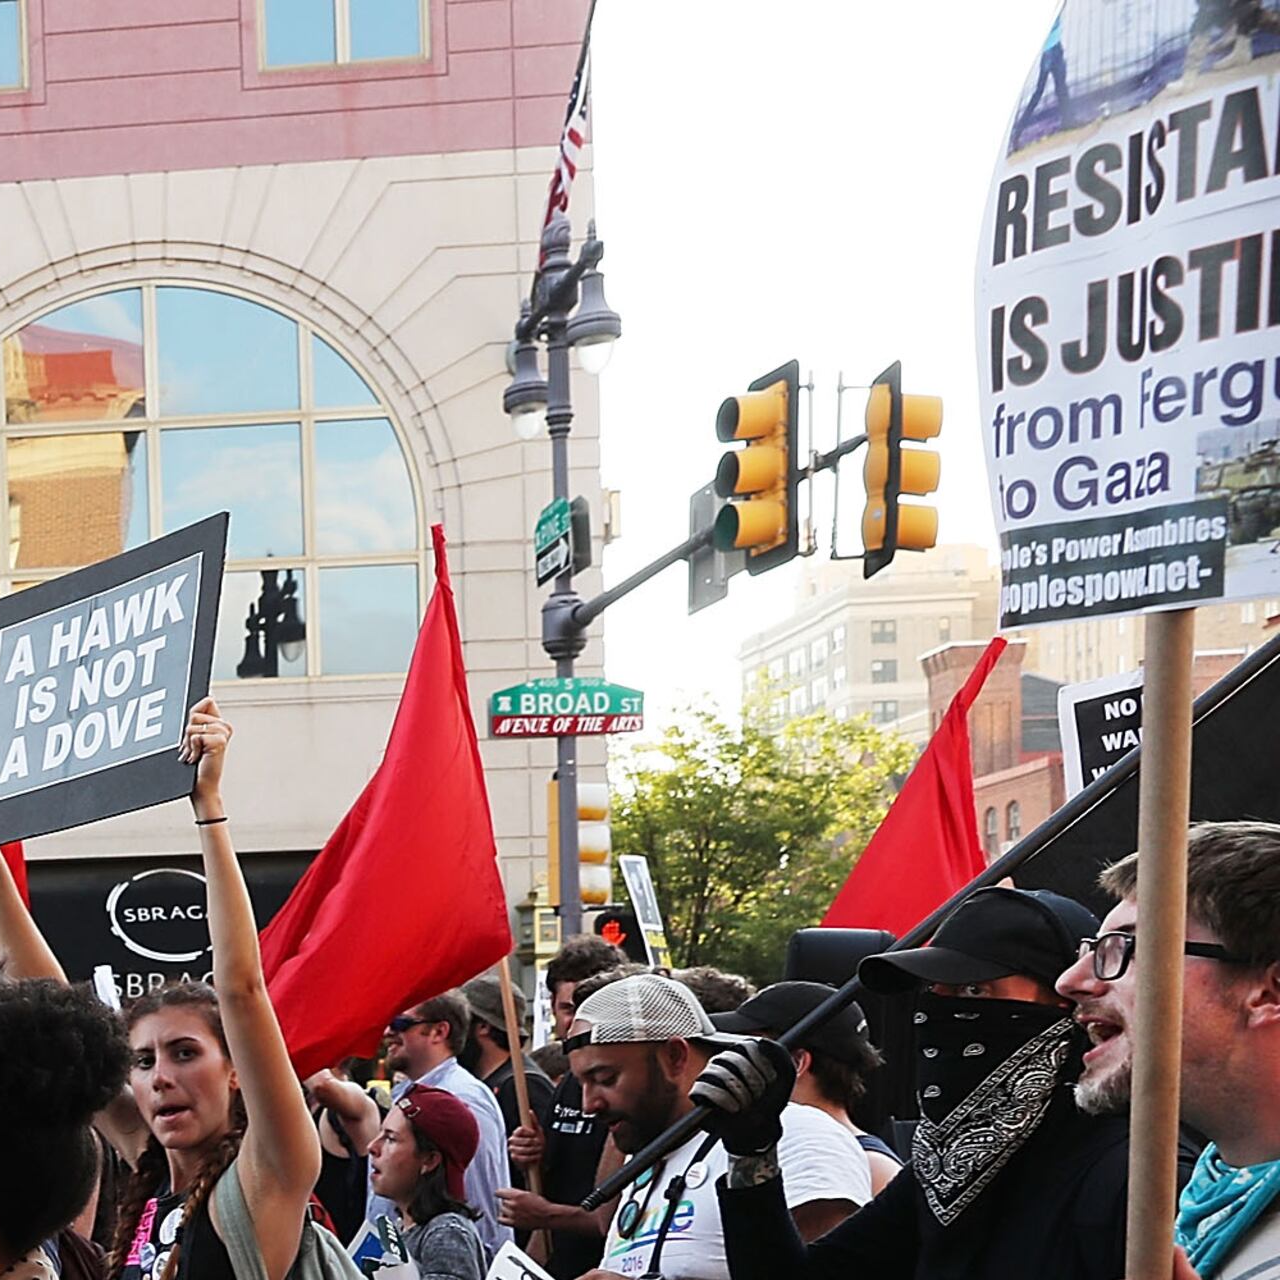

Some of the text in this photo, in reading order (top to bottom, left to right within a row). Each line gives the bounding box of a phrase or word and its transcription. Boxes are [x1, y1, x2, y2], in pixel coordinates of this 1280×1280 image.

[992, 86, 1280, 267] RESISTA
[991, 229, 1280, 393] IS JUSTI
[992, 393, 1123, 458] from
[1053, 451, 1170, 511] Gaza
[1052, 533, 1122, 564] Power
[4, 572, 191, 684] A HAWK
[14, 634, 168, 730] IS NOT
[520, 692, 641, 715] BROAD ST
[1104, 697, 1139, 722] NO
[41, 688, 168, 772] DOVE
[495, 715, 642, 734] AVENUE OF THE ARTS
[1101, 727, 1144, 752] WA
[123, 904, 209, 924] SBRAG
